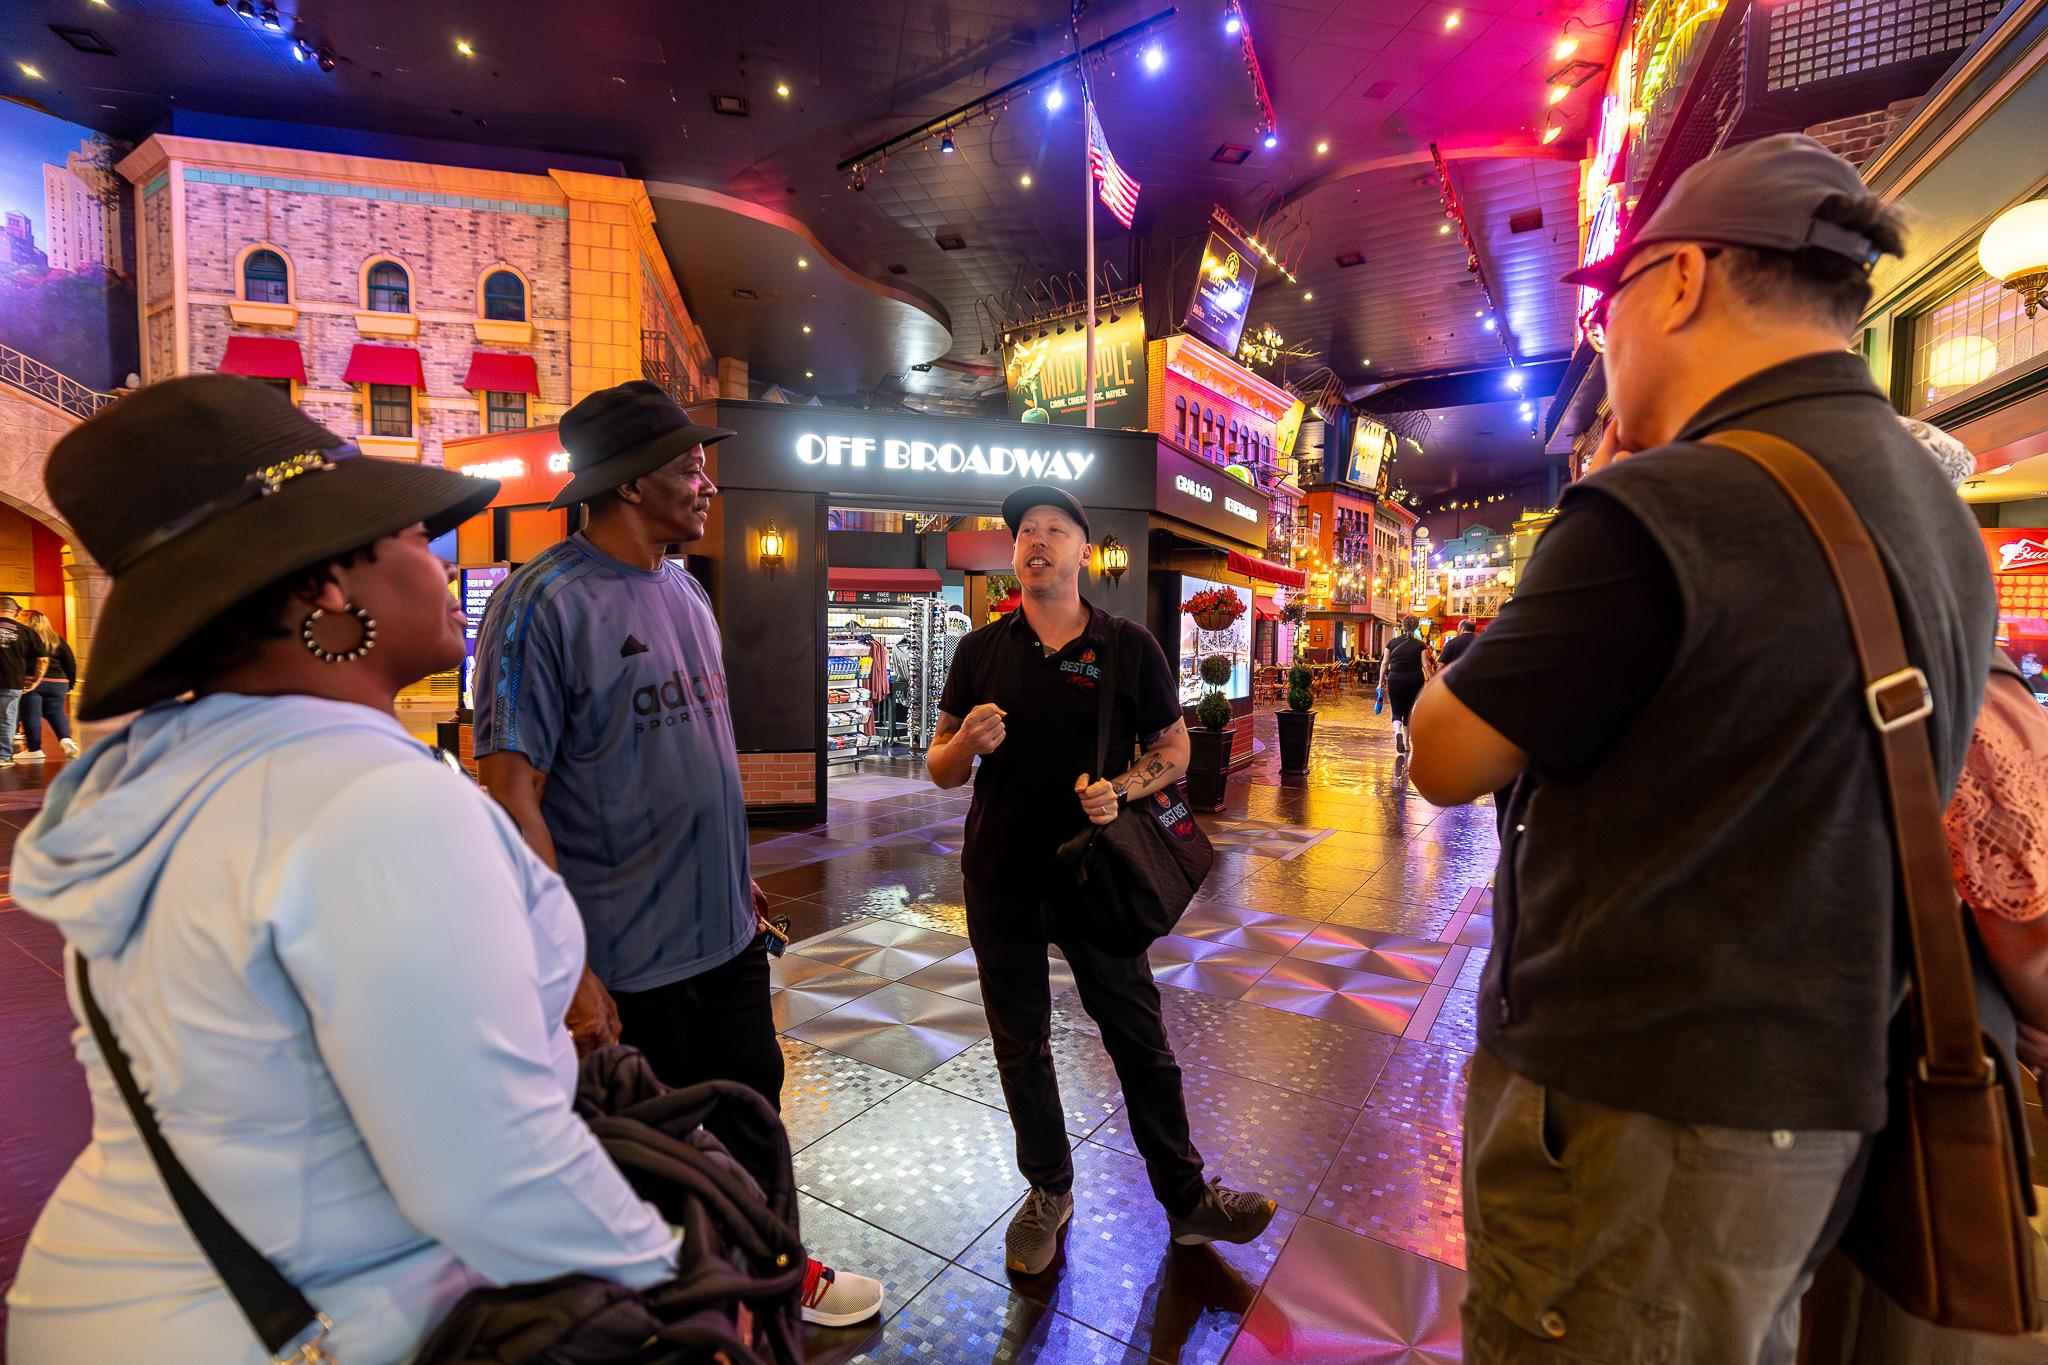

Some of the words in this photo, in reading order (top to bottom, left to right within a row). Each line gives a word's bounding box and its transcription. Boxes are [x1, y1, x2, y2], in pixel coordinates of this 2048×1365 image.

[1039, 352, 1078, 401] MAD
[796, 433, 876, 467] OFF
[884, 439, 1095, 480] BROADWAY
[1200, 485, 1213, 503] GO
[1060, 660, 1086, 674] BEST
[1159, 809, 1178, 828] BEST
[1172, 802, 1188, 819] BET
